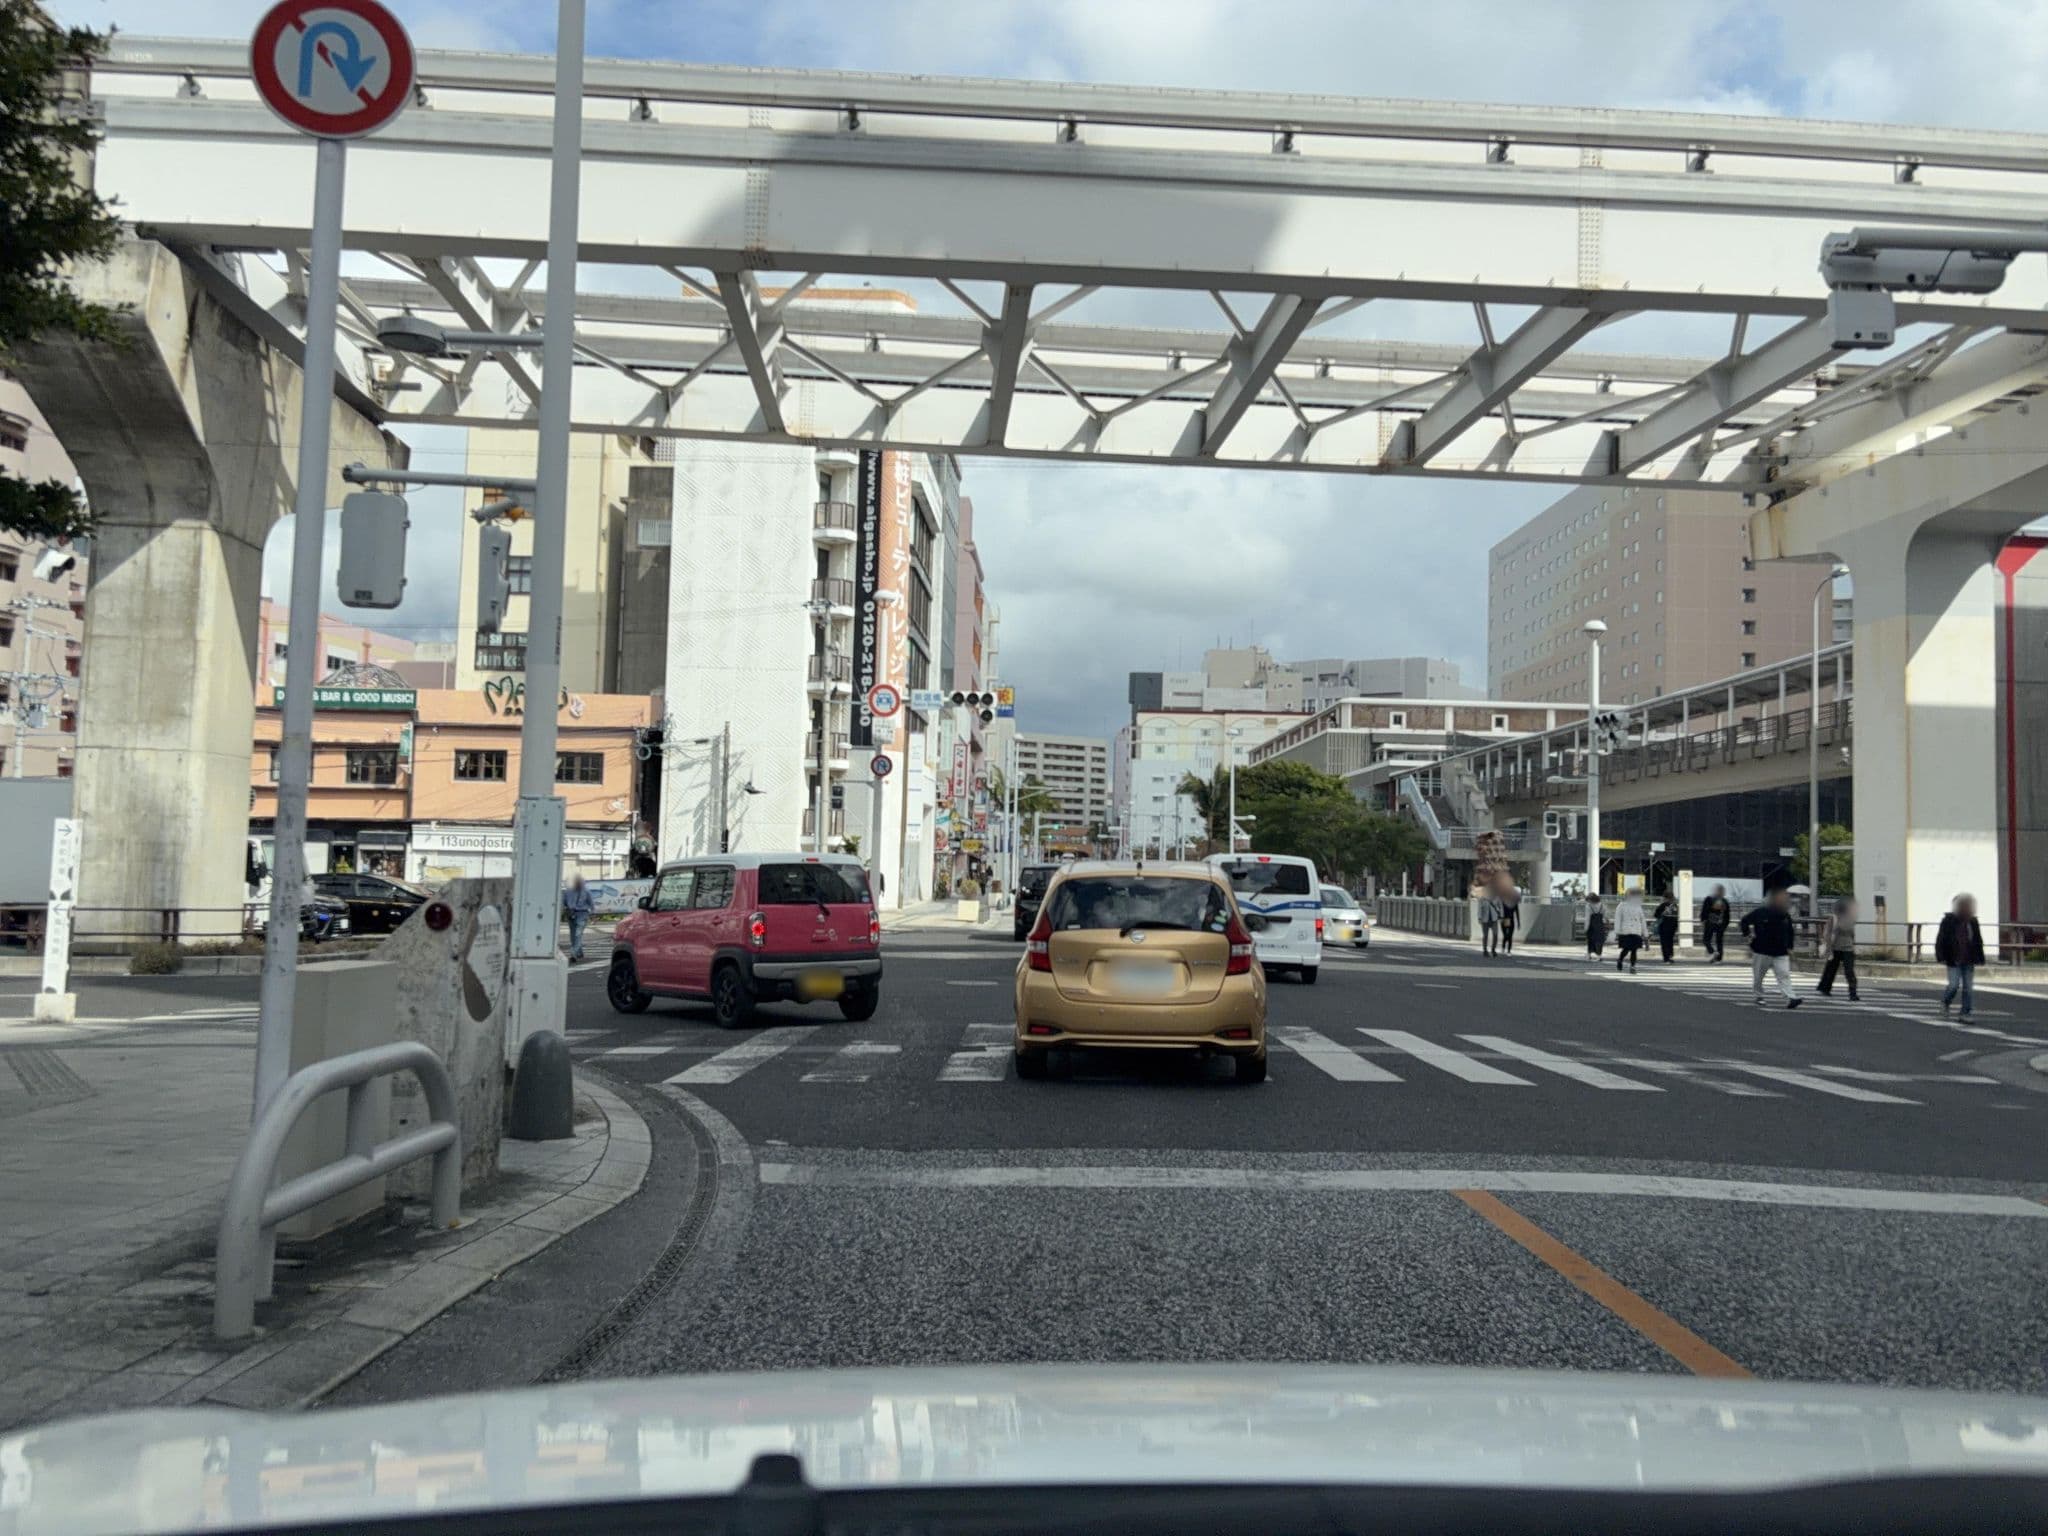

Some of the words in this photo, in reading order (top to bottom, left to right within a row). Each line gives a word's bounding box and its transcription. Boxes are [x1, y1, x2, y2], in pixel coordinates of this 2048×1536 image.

[320, 691, 341, 702] BAR
[342, 692, 351, 703] &
[353, 692, 380, 703] GOOD
